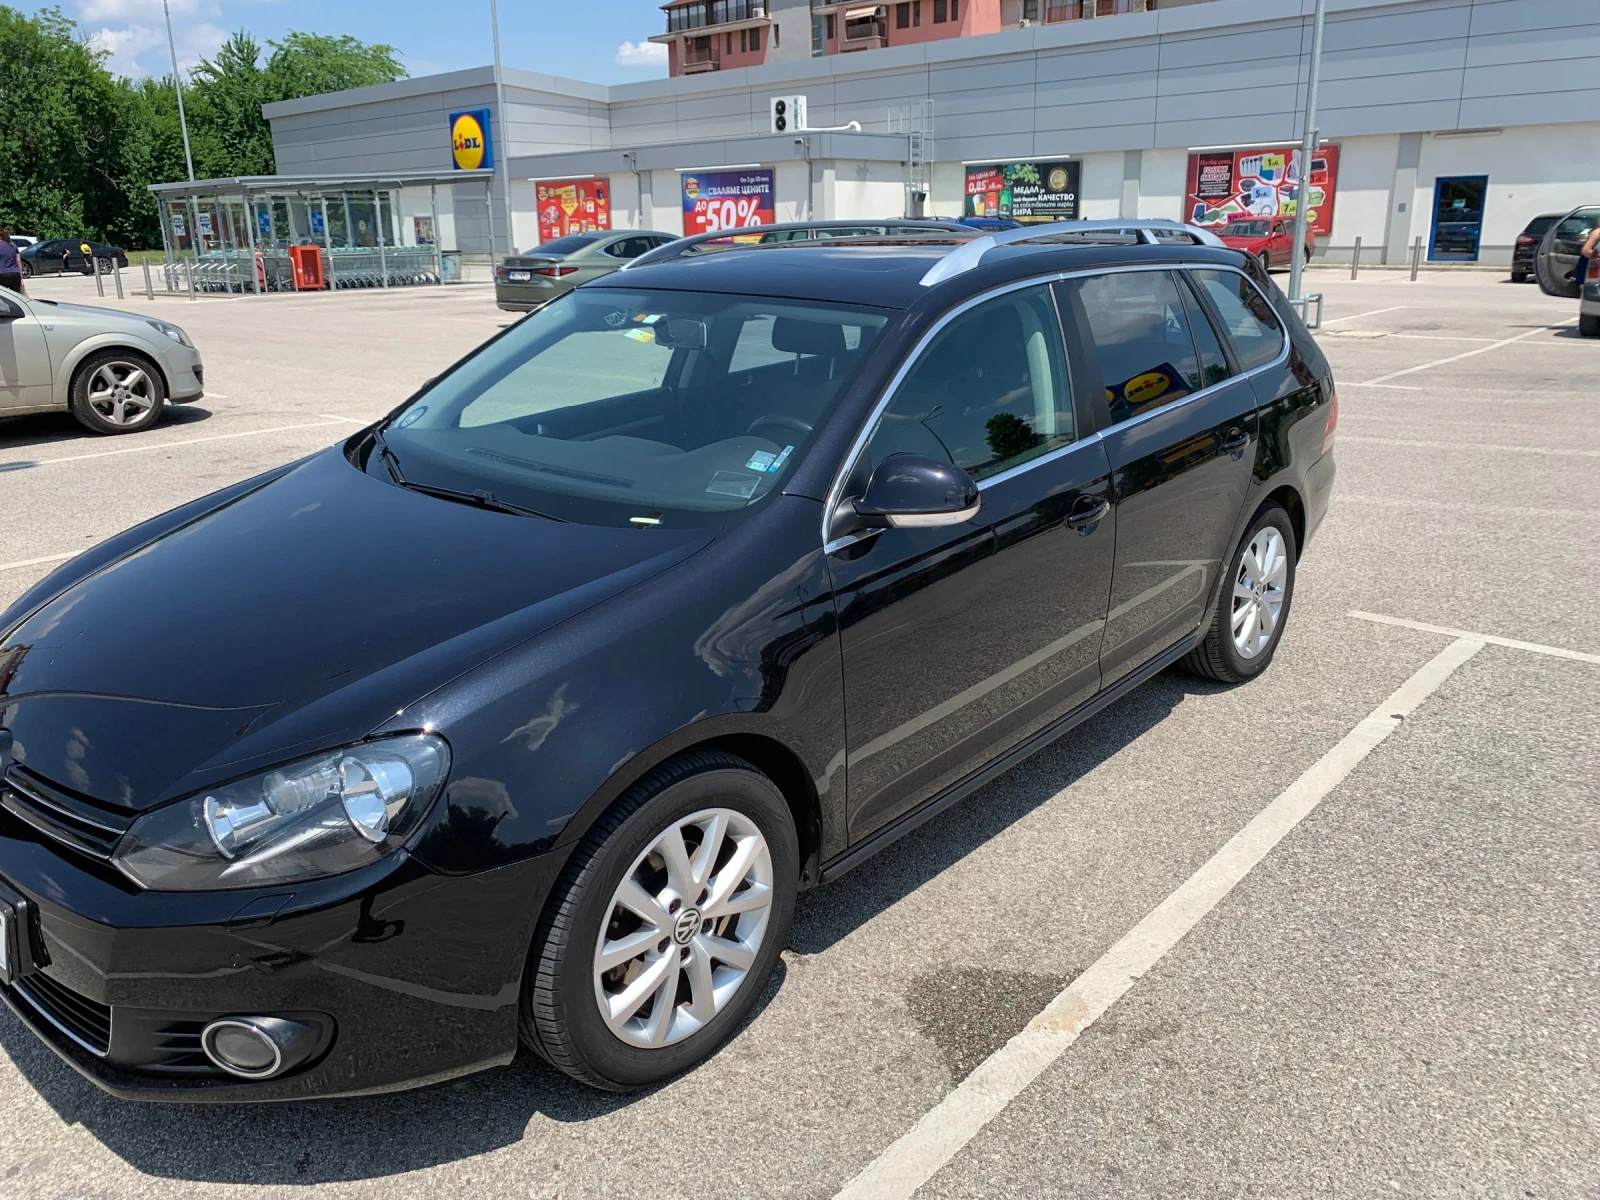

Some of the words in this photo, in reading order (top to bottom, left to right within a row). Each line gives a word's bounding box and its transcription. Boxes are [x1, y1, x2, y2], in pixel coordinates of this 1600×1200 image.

[1267, 158, 1271, 166] 1
[976, 171, 989, 179] ЦЕНА
[1200, 173, 1230, 181] НАХОДКИ
[708, 186, 740, 195] СВАЛЯМЕ
[741, 184, 770, 195] ЦЕНИТЕ
[1013, 186, 1039, 195] МЕДАЛ
[1255, 189, 1260, 198] 5
[1038, 193, 1074, 201] КАЧЕСТВО
[695, 200, 707, 212] ДО
[1284, 204, 1290, 212] 7
[696, 199, 761, 233] -50%
[1013, 208, 1032, 216] БИРА
